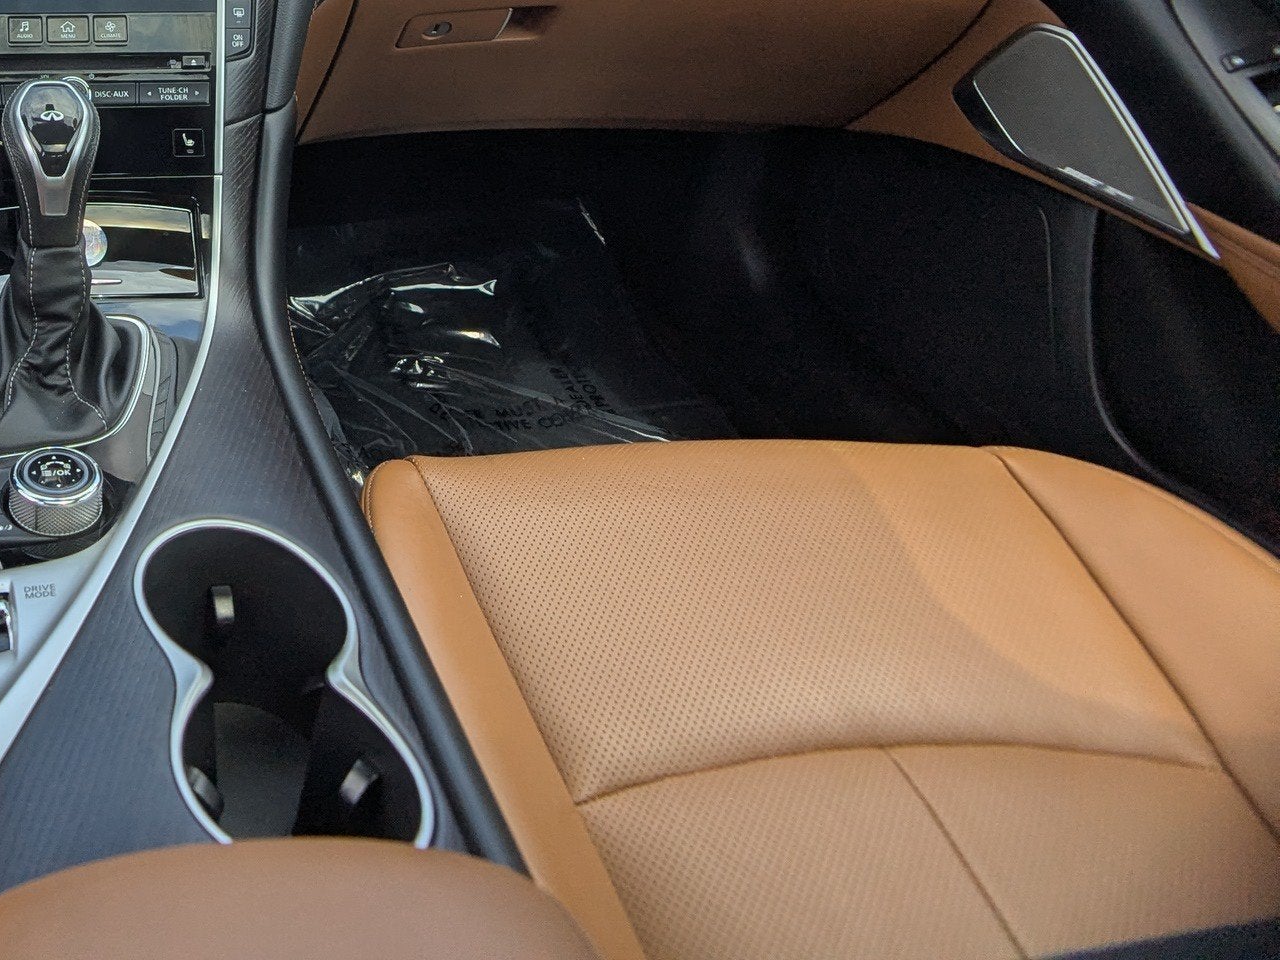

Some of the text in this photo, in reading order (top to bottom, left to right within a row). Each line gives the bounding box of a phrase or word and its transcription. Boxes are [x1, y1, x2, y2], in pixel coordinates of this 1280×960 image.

[231, 40, 244, 48] OFF
[23, 583, 57, 593] DRIVE
[24, 590, 57, 599] MODE
